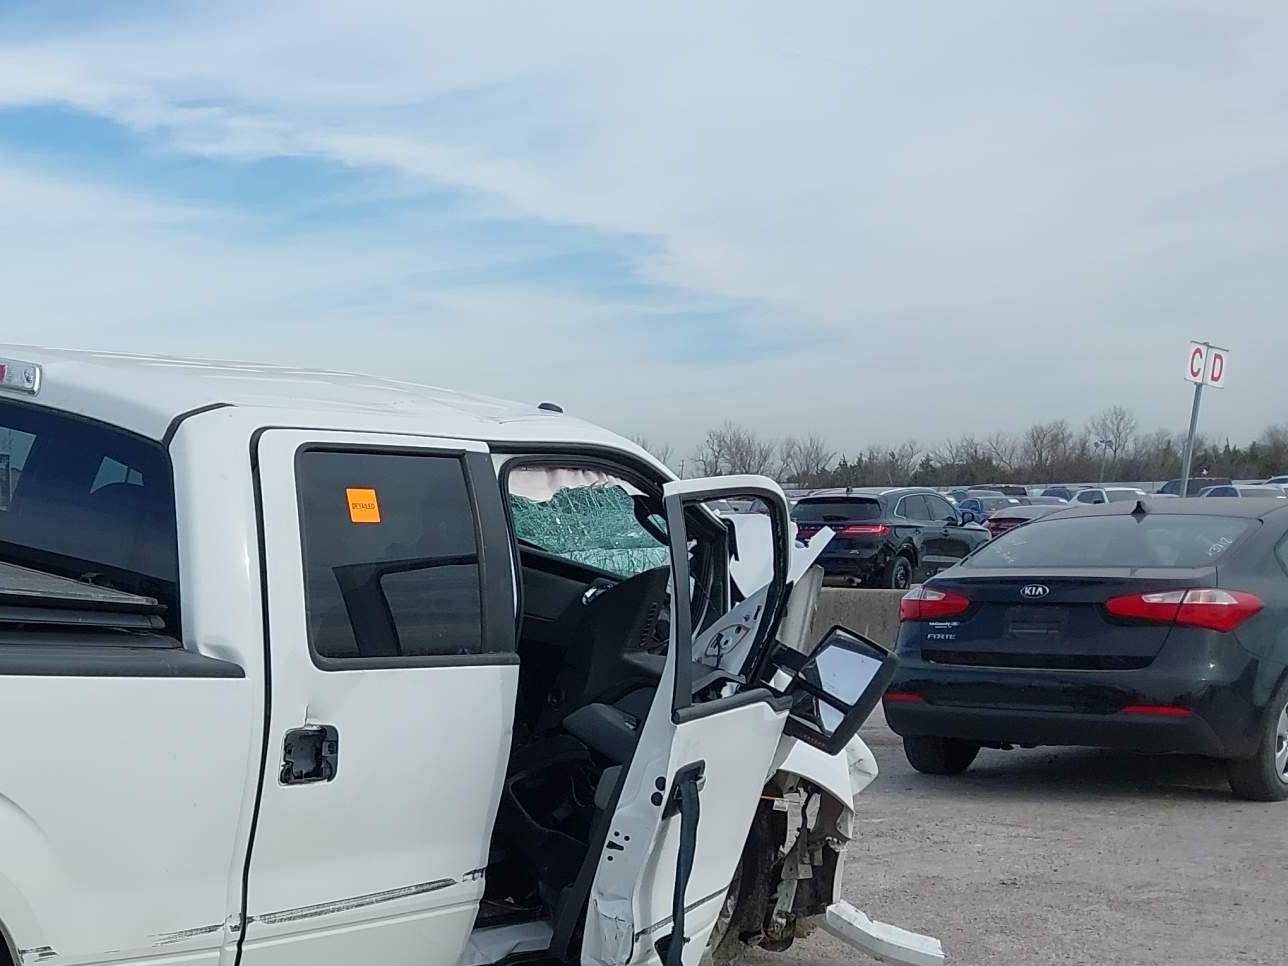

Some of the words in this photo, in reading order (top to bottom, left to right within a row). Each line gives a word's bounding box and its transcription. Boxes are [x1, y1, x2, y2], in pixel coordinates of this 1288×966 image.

[1190, 347, 1203, 378] C
[1211, 352, 1224, 382] D
[1024, 586, 1044, 596] KIA
